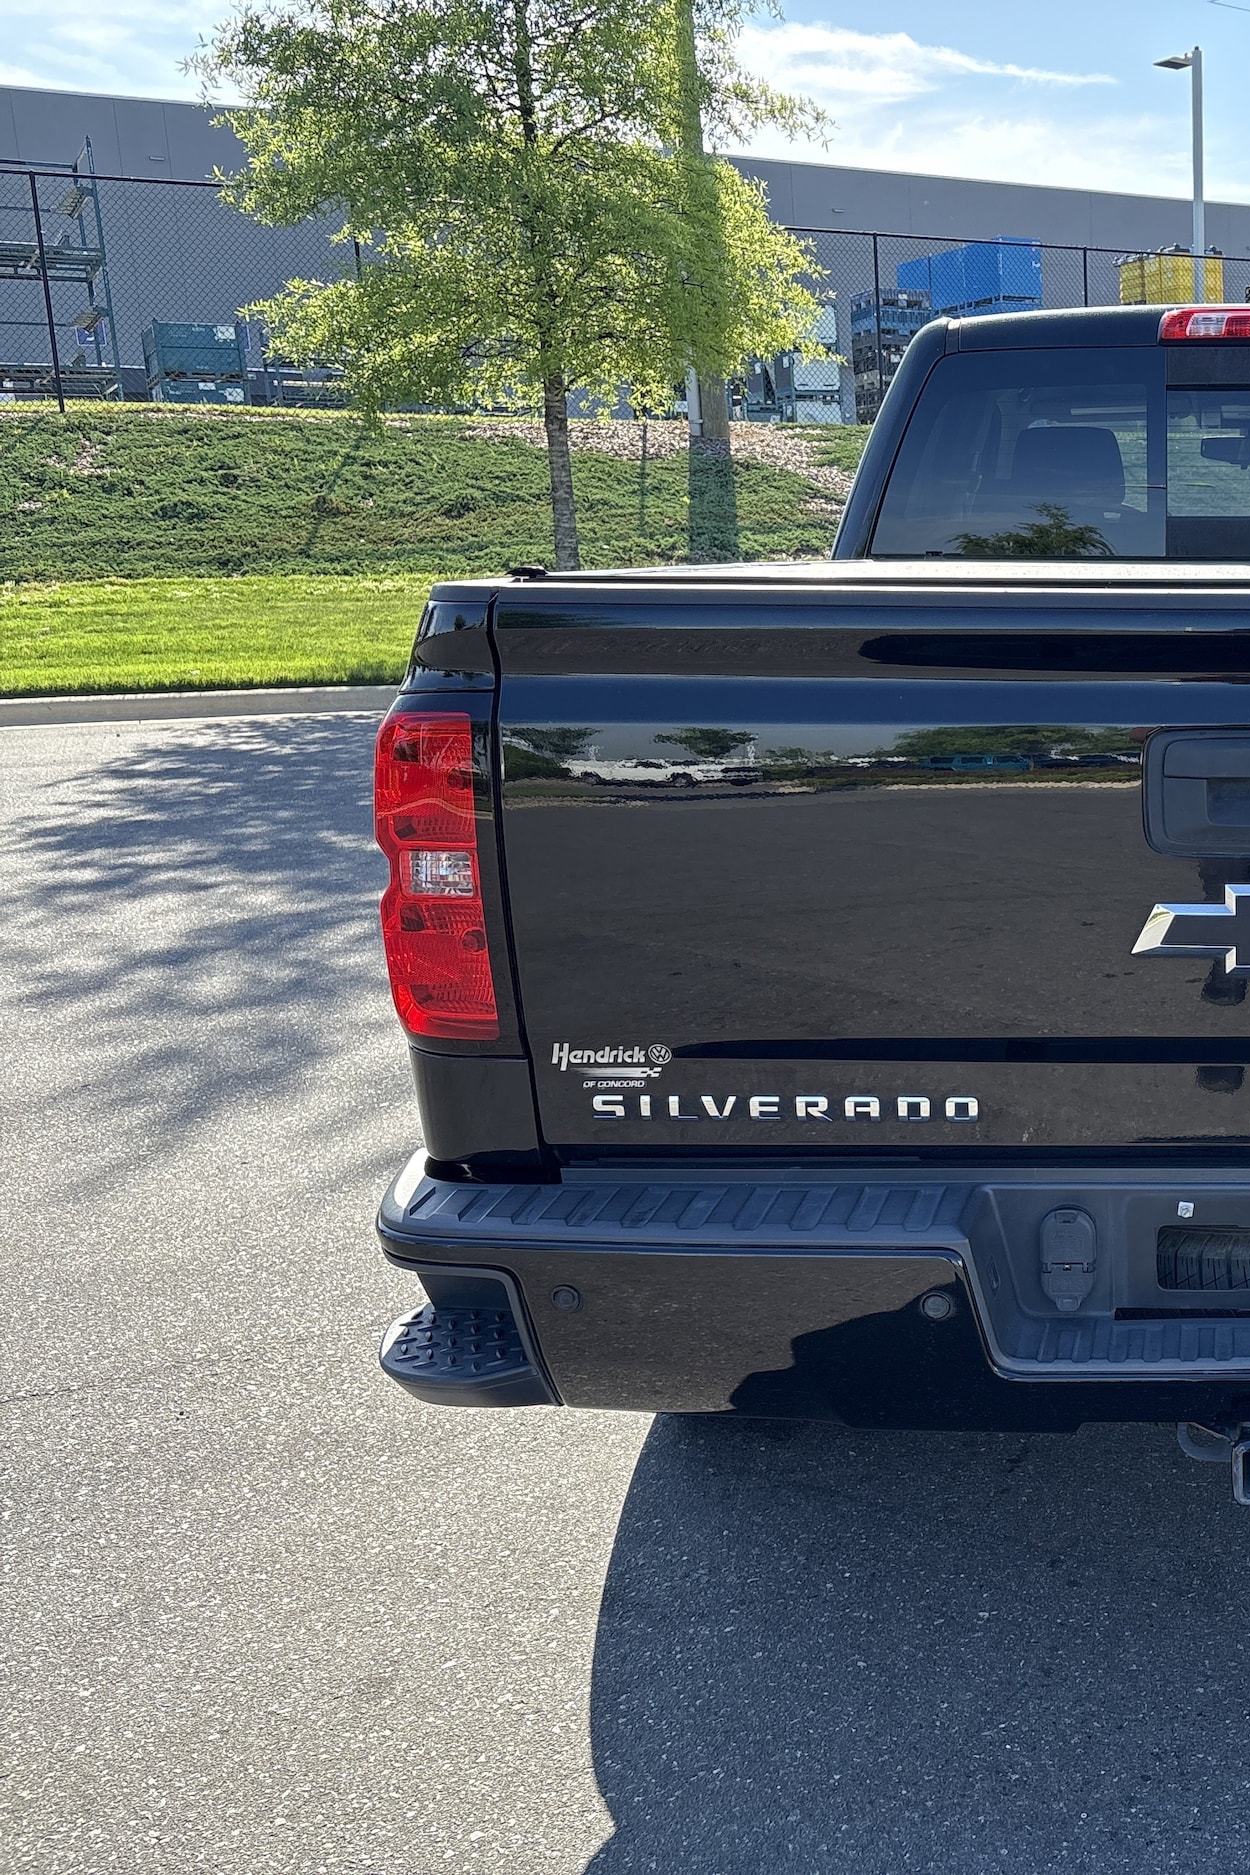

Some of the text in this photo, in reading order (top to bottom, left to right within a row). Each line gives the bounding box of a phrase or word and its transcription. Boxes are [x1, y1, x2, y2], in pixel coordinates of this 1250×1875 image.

[551, 1043, 646, 1071] Hendrick
[597, 1080, 645, 1088] CONCORD
[592, 1095, 980, 1121] SILVERADO
